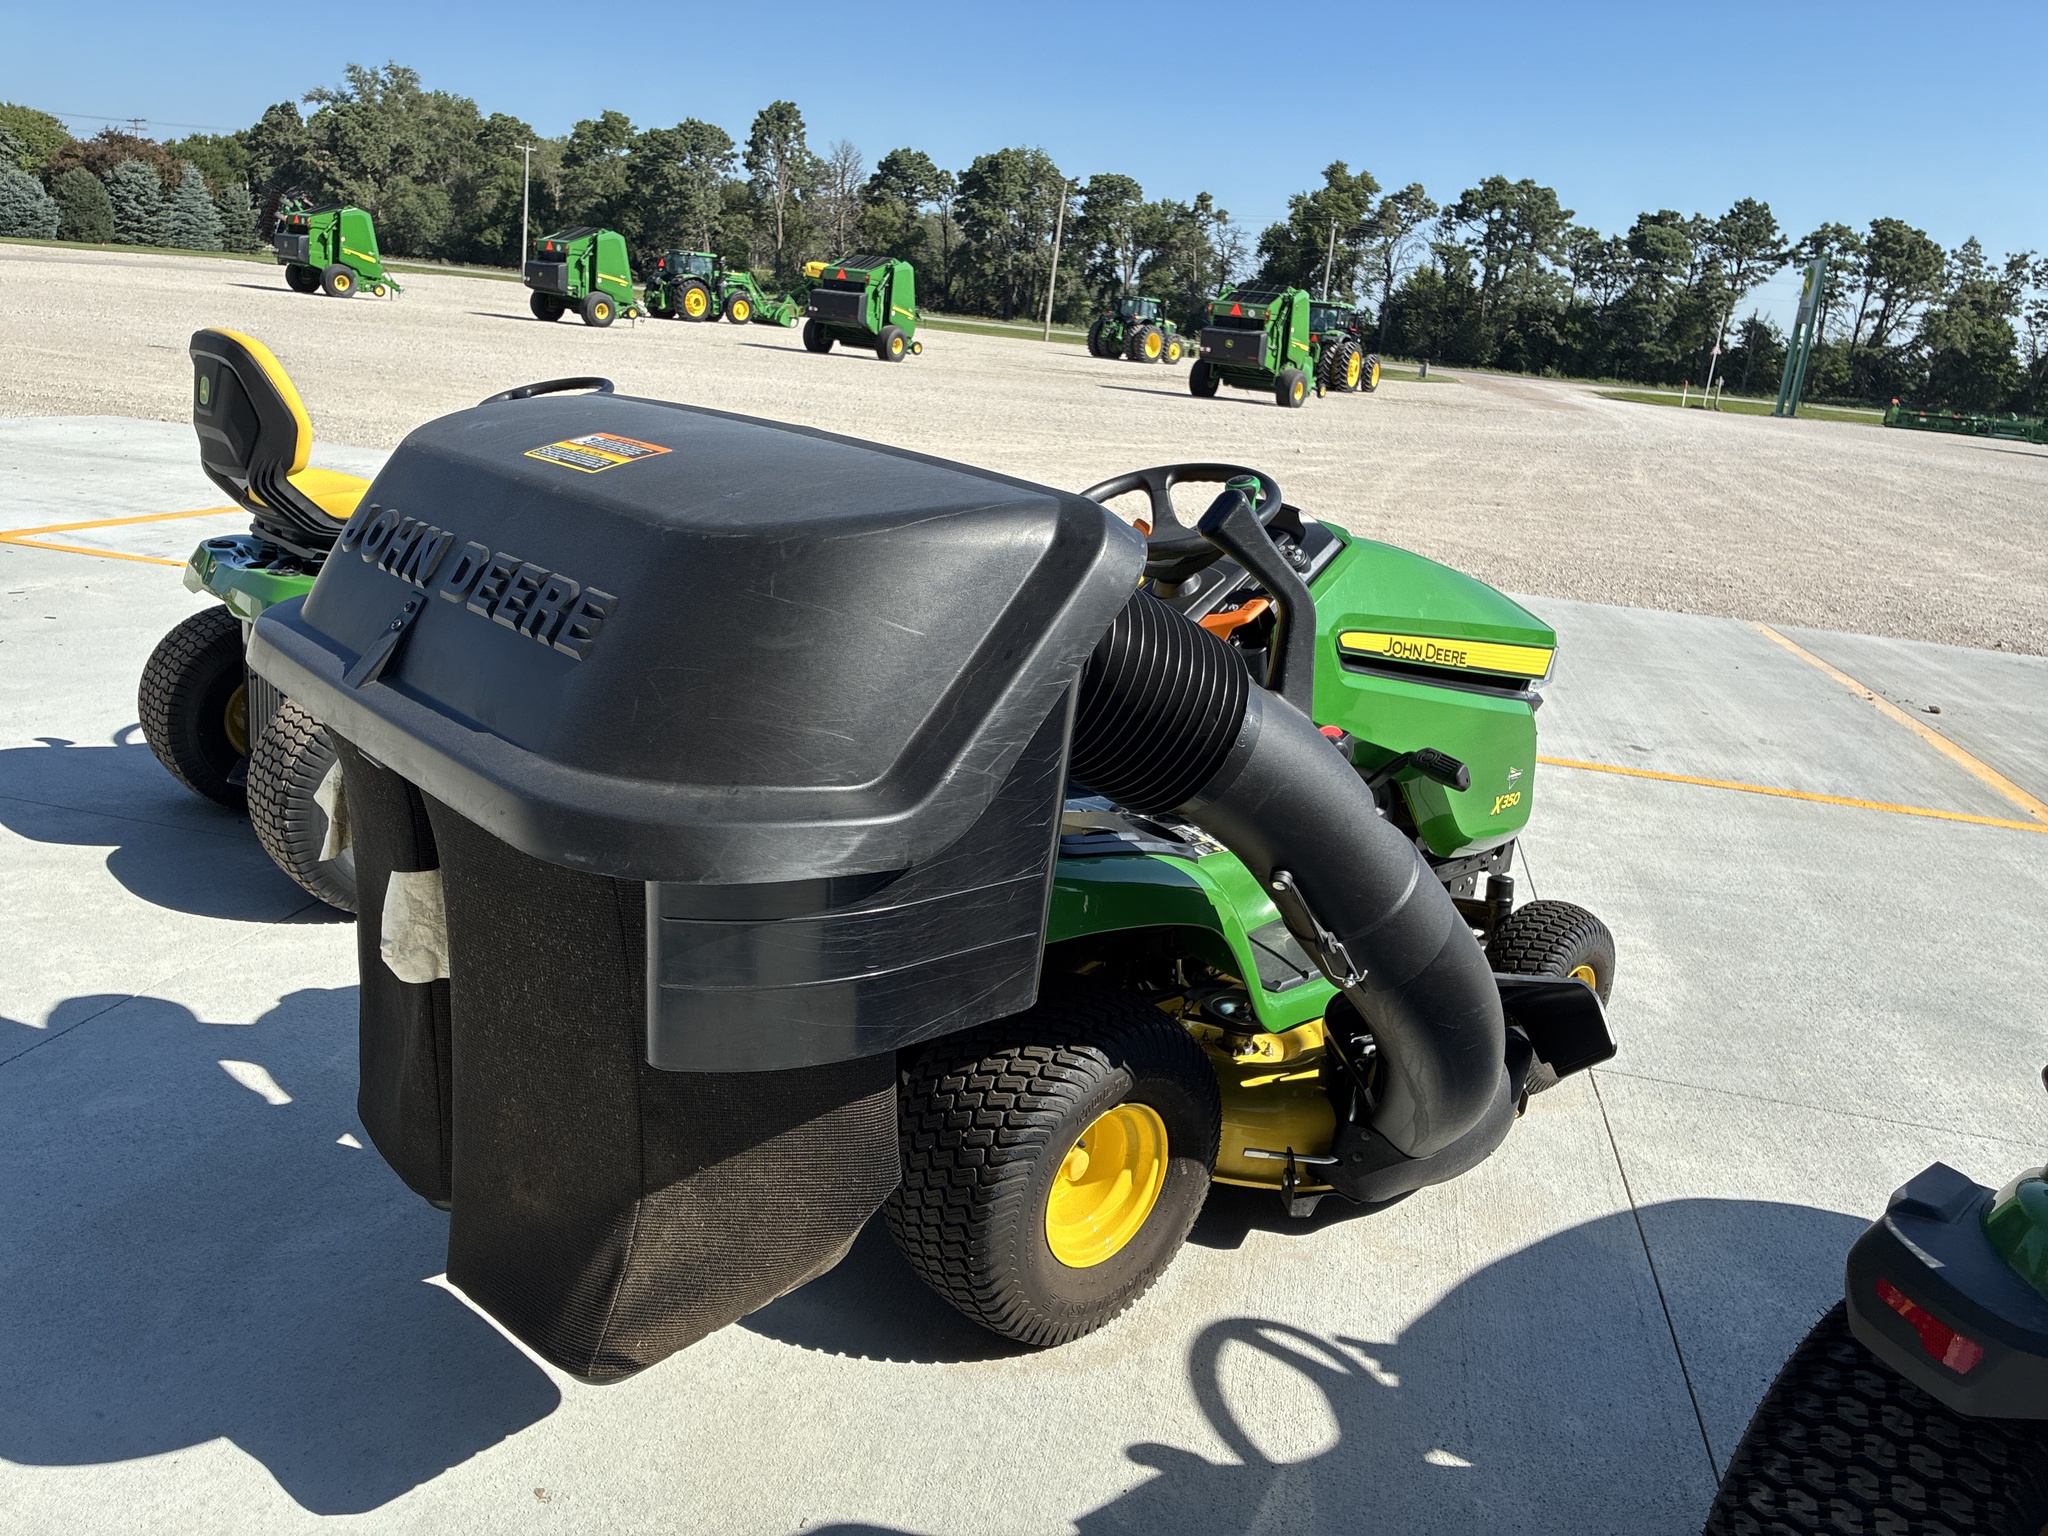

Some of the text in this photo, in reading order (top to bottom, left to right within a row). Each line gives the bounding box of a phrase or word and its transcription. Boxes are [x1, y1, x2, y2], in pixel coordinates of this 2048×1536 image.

[341, 503, 619, 662] JOHN DEERE
[1383, 637, 1467, 665] JOHN DEERE
[1490, 791, 1521, 816] X350
[1041, 1260, 1155, 1318] CARLISLE
